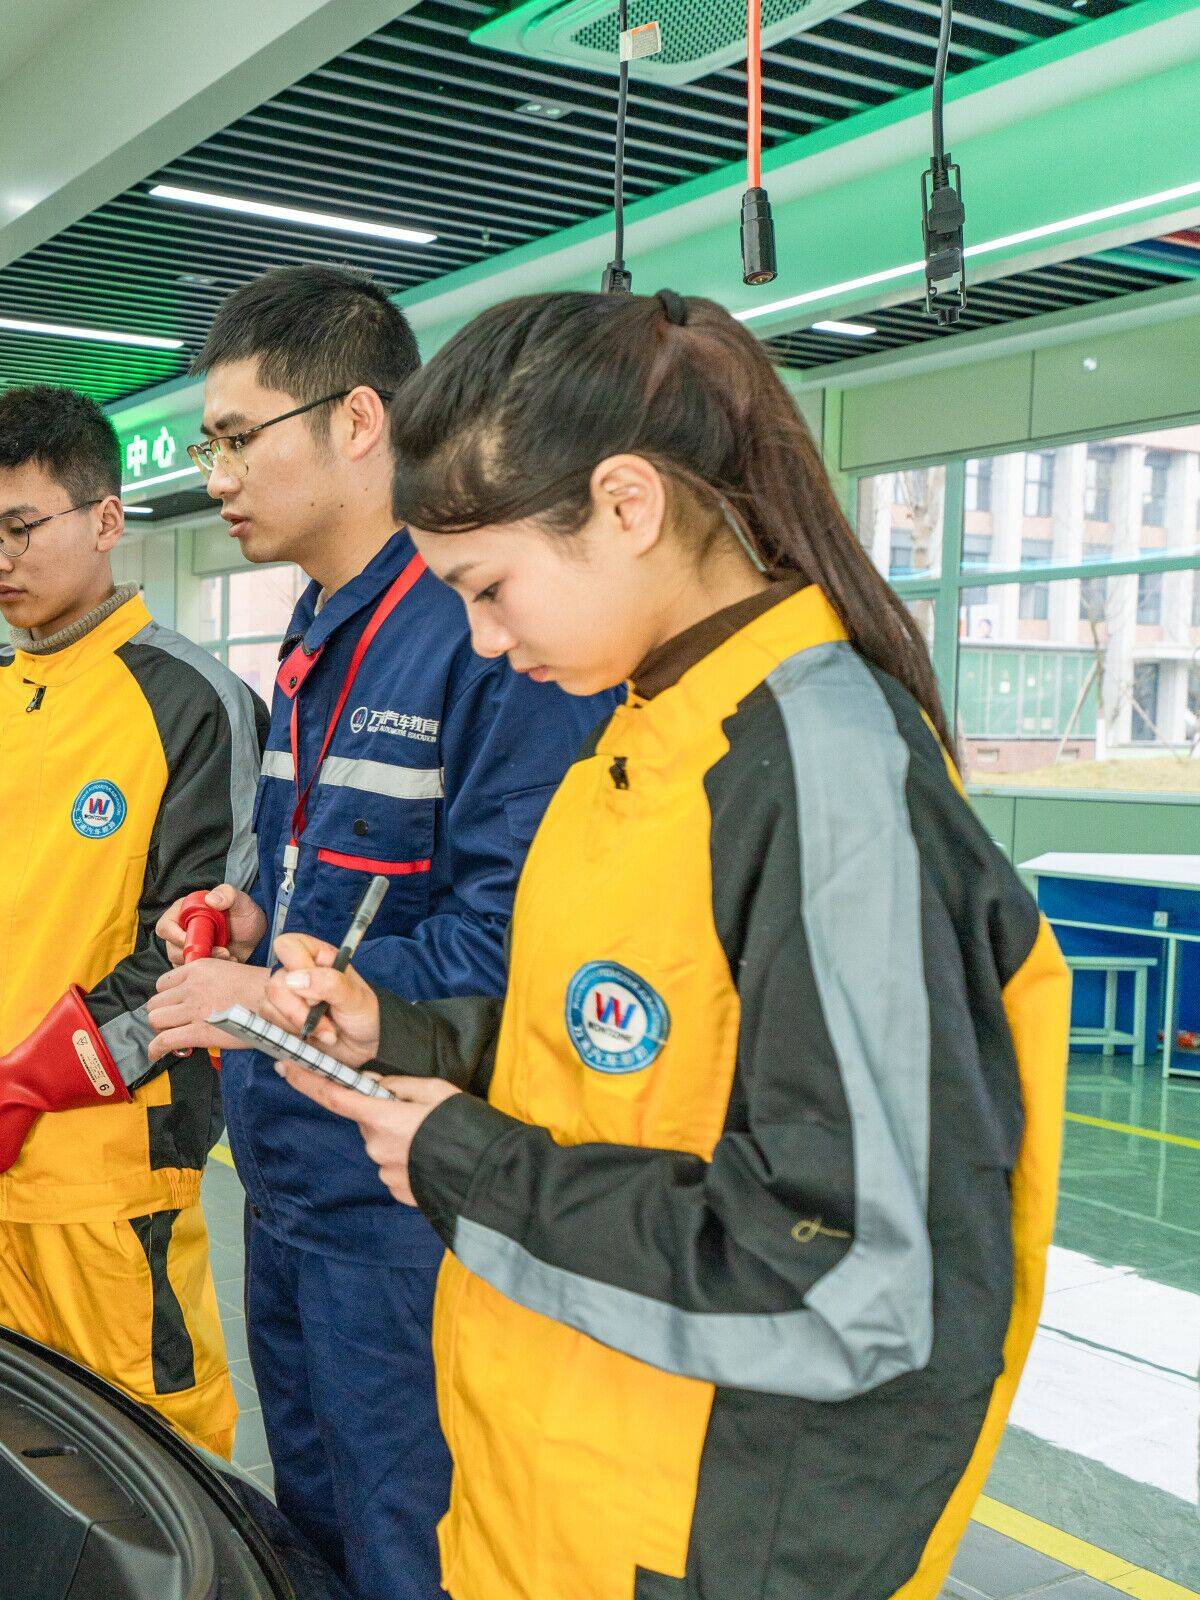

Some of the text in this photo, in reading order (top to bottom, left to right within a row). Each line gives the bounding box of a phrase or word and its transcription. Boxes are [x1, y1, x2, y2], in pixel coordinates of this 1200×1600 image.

[126, 426, 176, 476] 中心
[88, 797, 111, 815] W
[595, 990, 637, 1030] W
